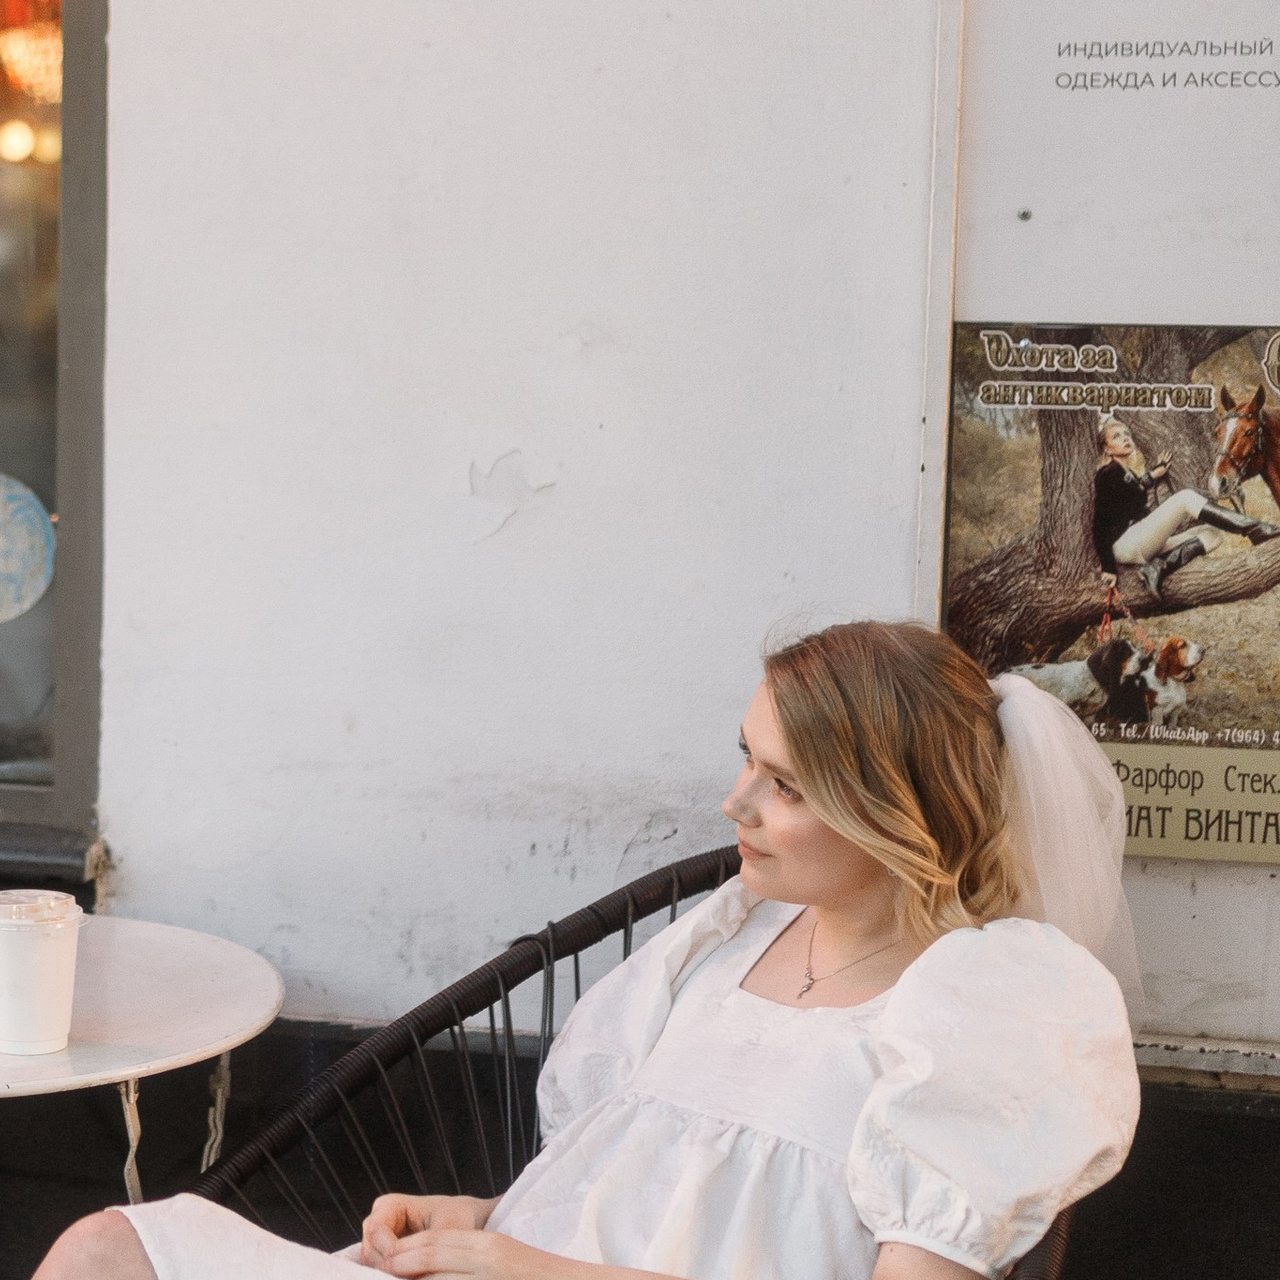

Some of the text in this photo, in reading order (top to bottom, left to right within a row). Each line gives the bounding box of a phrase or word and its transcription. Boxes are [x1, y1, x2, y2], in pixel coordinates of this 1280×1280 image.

[1058, 37, 1274, 58] ИНДИВИДУАЛЬНЫЙ
[1055, 71, 1155, 90] ОДЕЖДА
[1162, 71, 1177, 88] И
[981, 331, 1116, 371] Охота за
[979, 382, 1213, 415] антиквариатом
[1224, 765, 1280, 794] Стек
